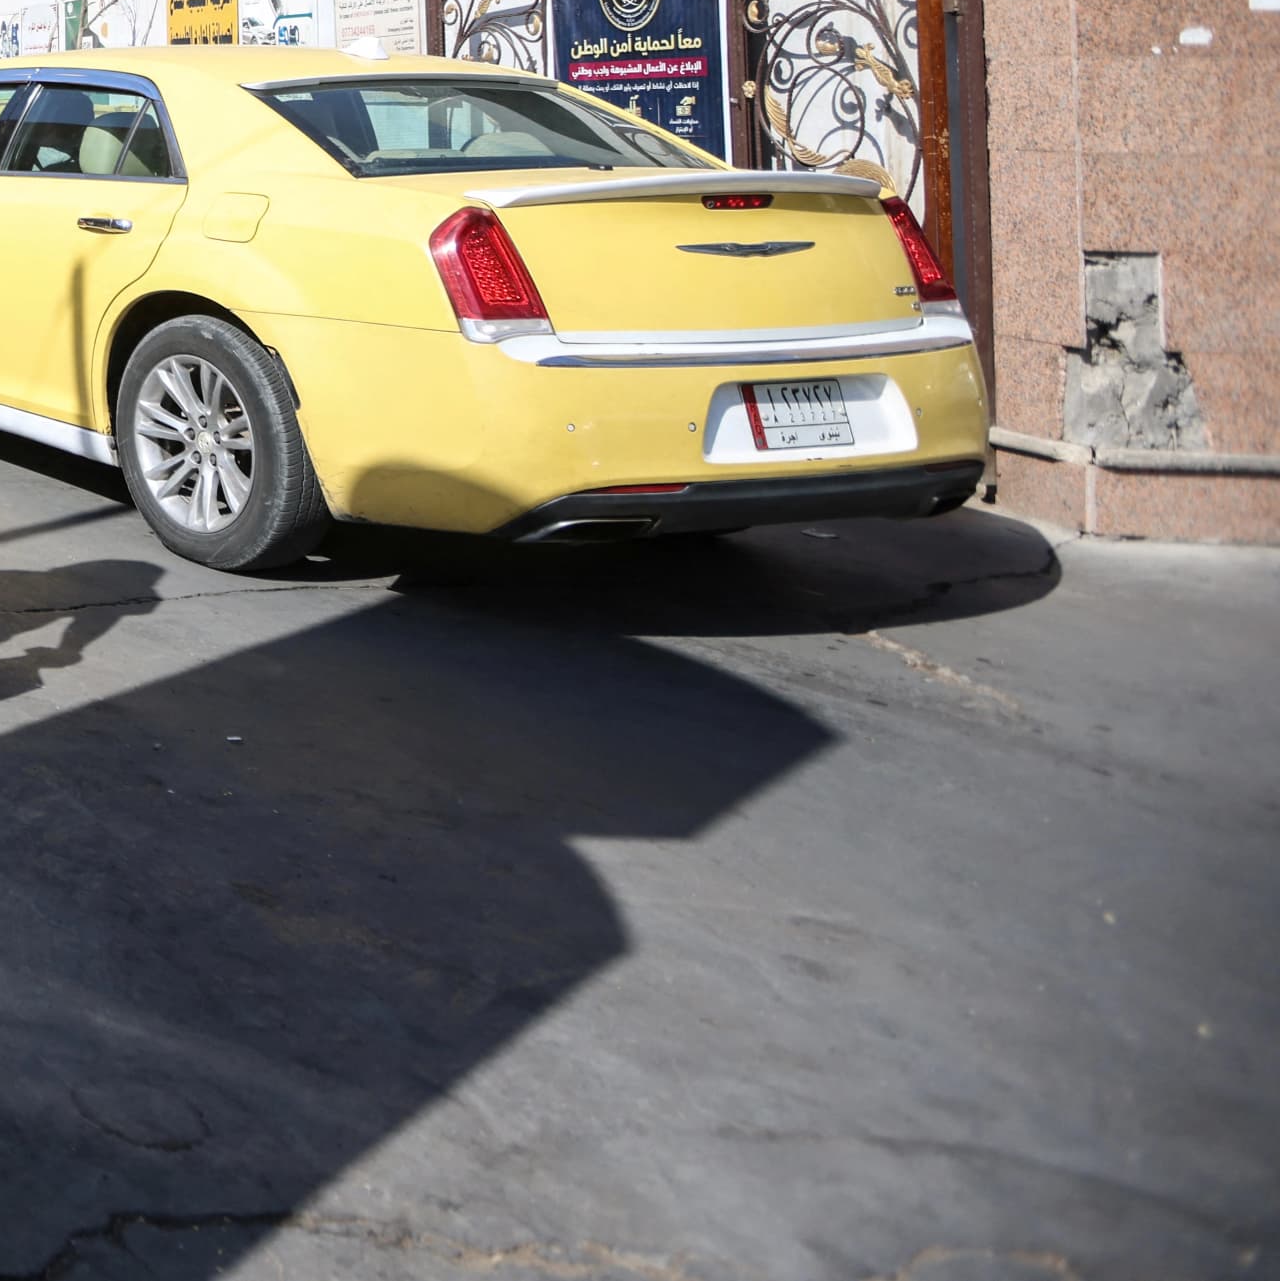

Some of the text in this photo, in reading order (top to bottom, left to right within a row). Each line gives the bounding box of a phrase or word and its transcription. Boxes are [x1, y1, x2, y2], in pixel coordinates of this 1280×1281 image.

[570, 38, 608, 60] الوطن
[610, 33, 633, 58] أمن
[633, 34, 675, 56] لحماية
[571, 66, 592, 80] وطني
[667, 64, 679, 74] عن
